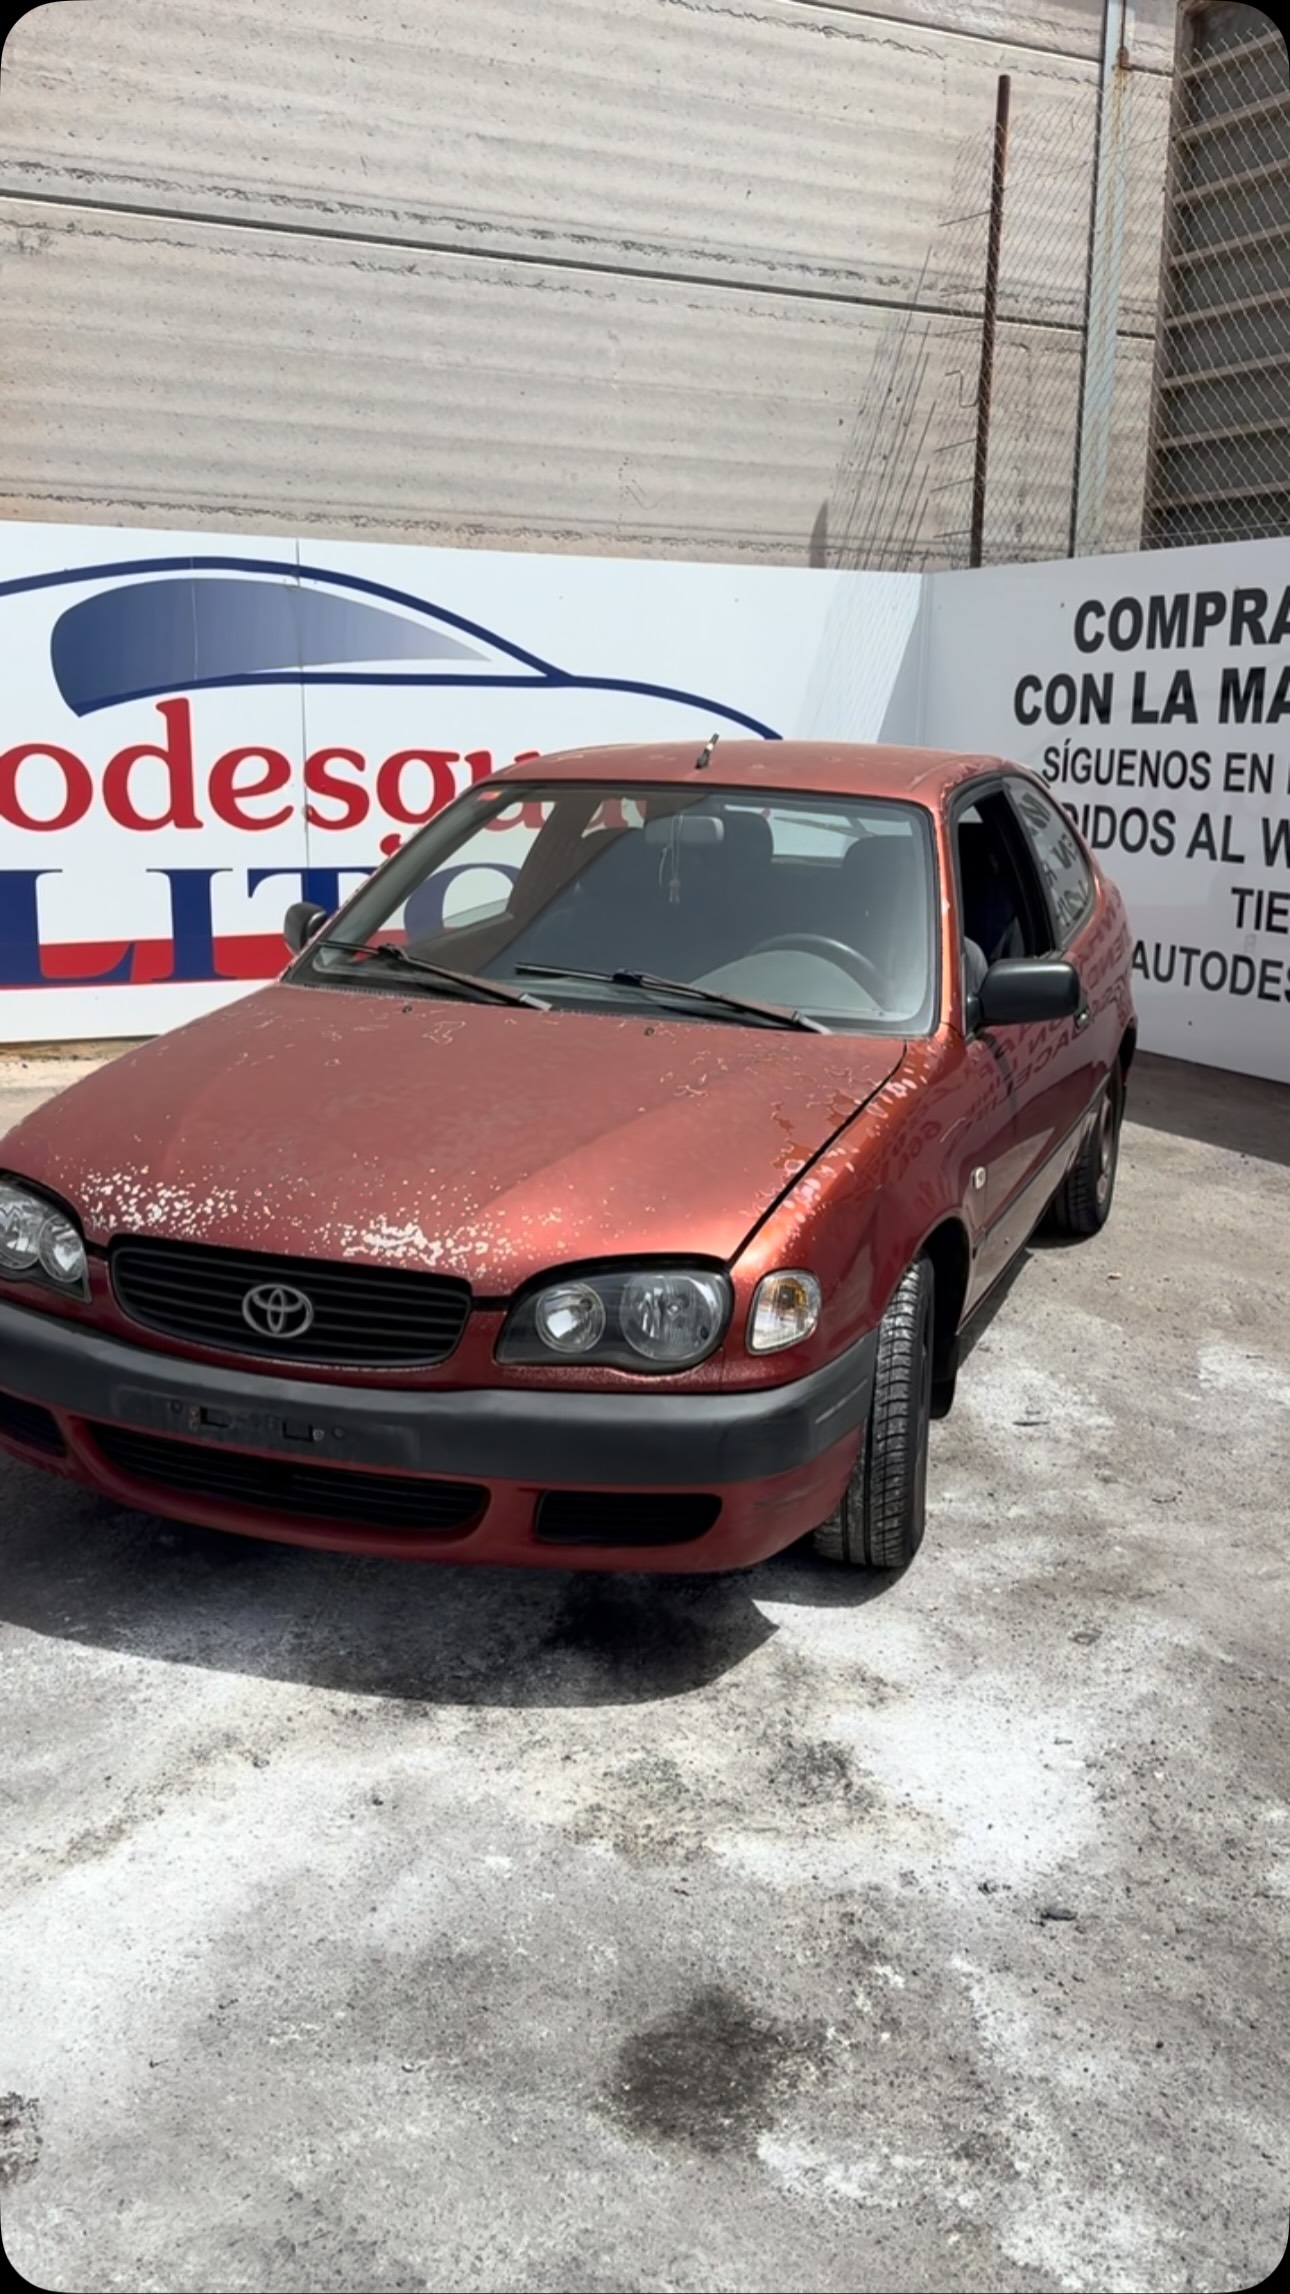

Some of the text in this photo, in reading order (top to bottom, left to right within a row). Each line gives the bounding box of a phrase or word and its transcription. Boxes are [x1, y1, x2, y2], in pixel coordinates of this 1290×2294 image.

[1074, 585, 1290, 654] COMPRA
[1014, 665, 1290, 725] CON LA MA
[1042, 738, 1211, 791] SÍGUENOS
[1223, 752, 1274, 794] EN
[1186, 812, 1245, 864] AL
[1231, 887, 1290, 934] TIE
[1132, 940, 1290, 1004] AUTODE
